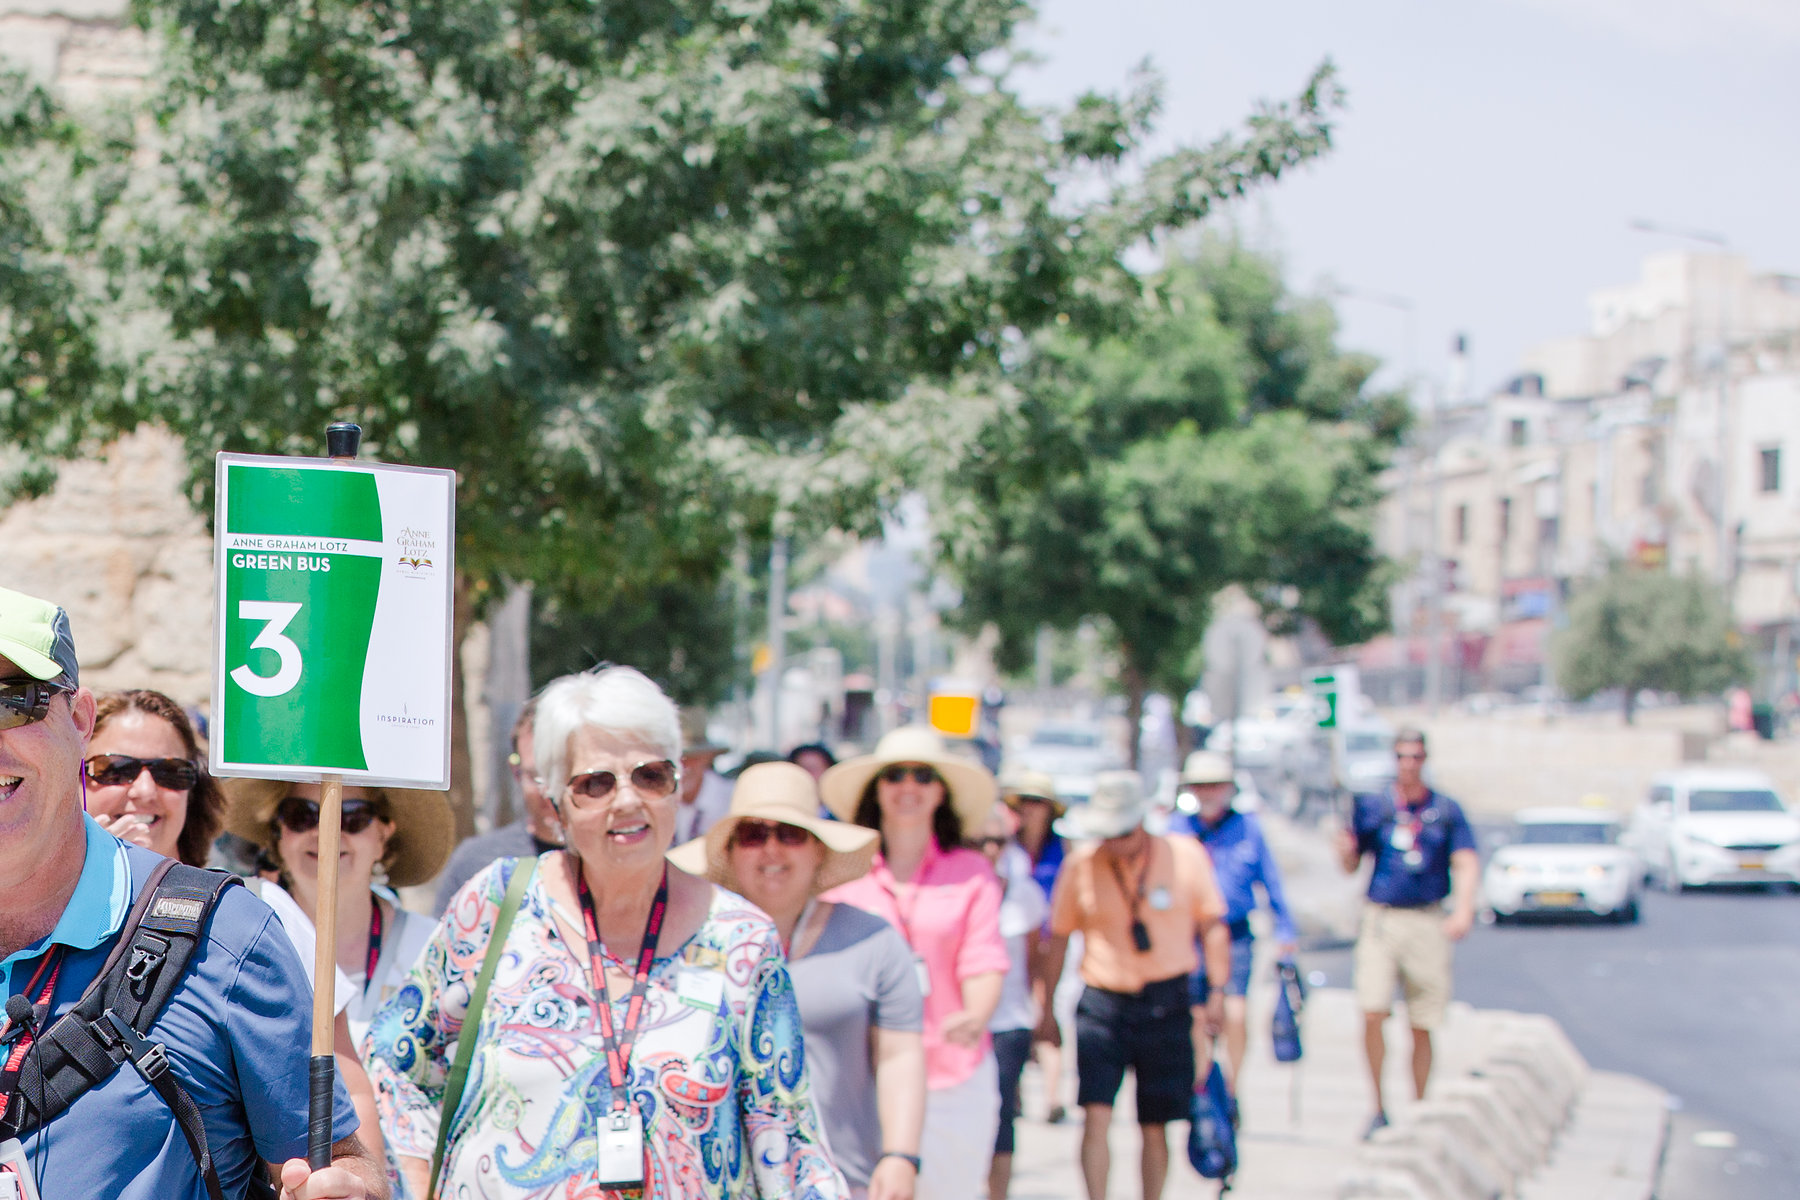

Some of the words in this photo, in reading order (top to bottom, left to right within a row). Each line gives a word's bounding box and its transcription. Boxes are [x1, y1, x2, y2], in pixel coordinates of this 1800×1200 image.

[233, 538, 263, 548] ANNE
[266, 539, 317, 550] GRAHAM
[320, 542, 348, 552] LOTZ
[232, 553, 292, 571] GREEN
[297, 556, 331, 572] BUS
[229, 600, 303, 697] 3
